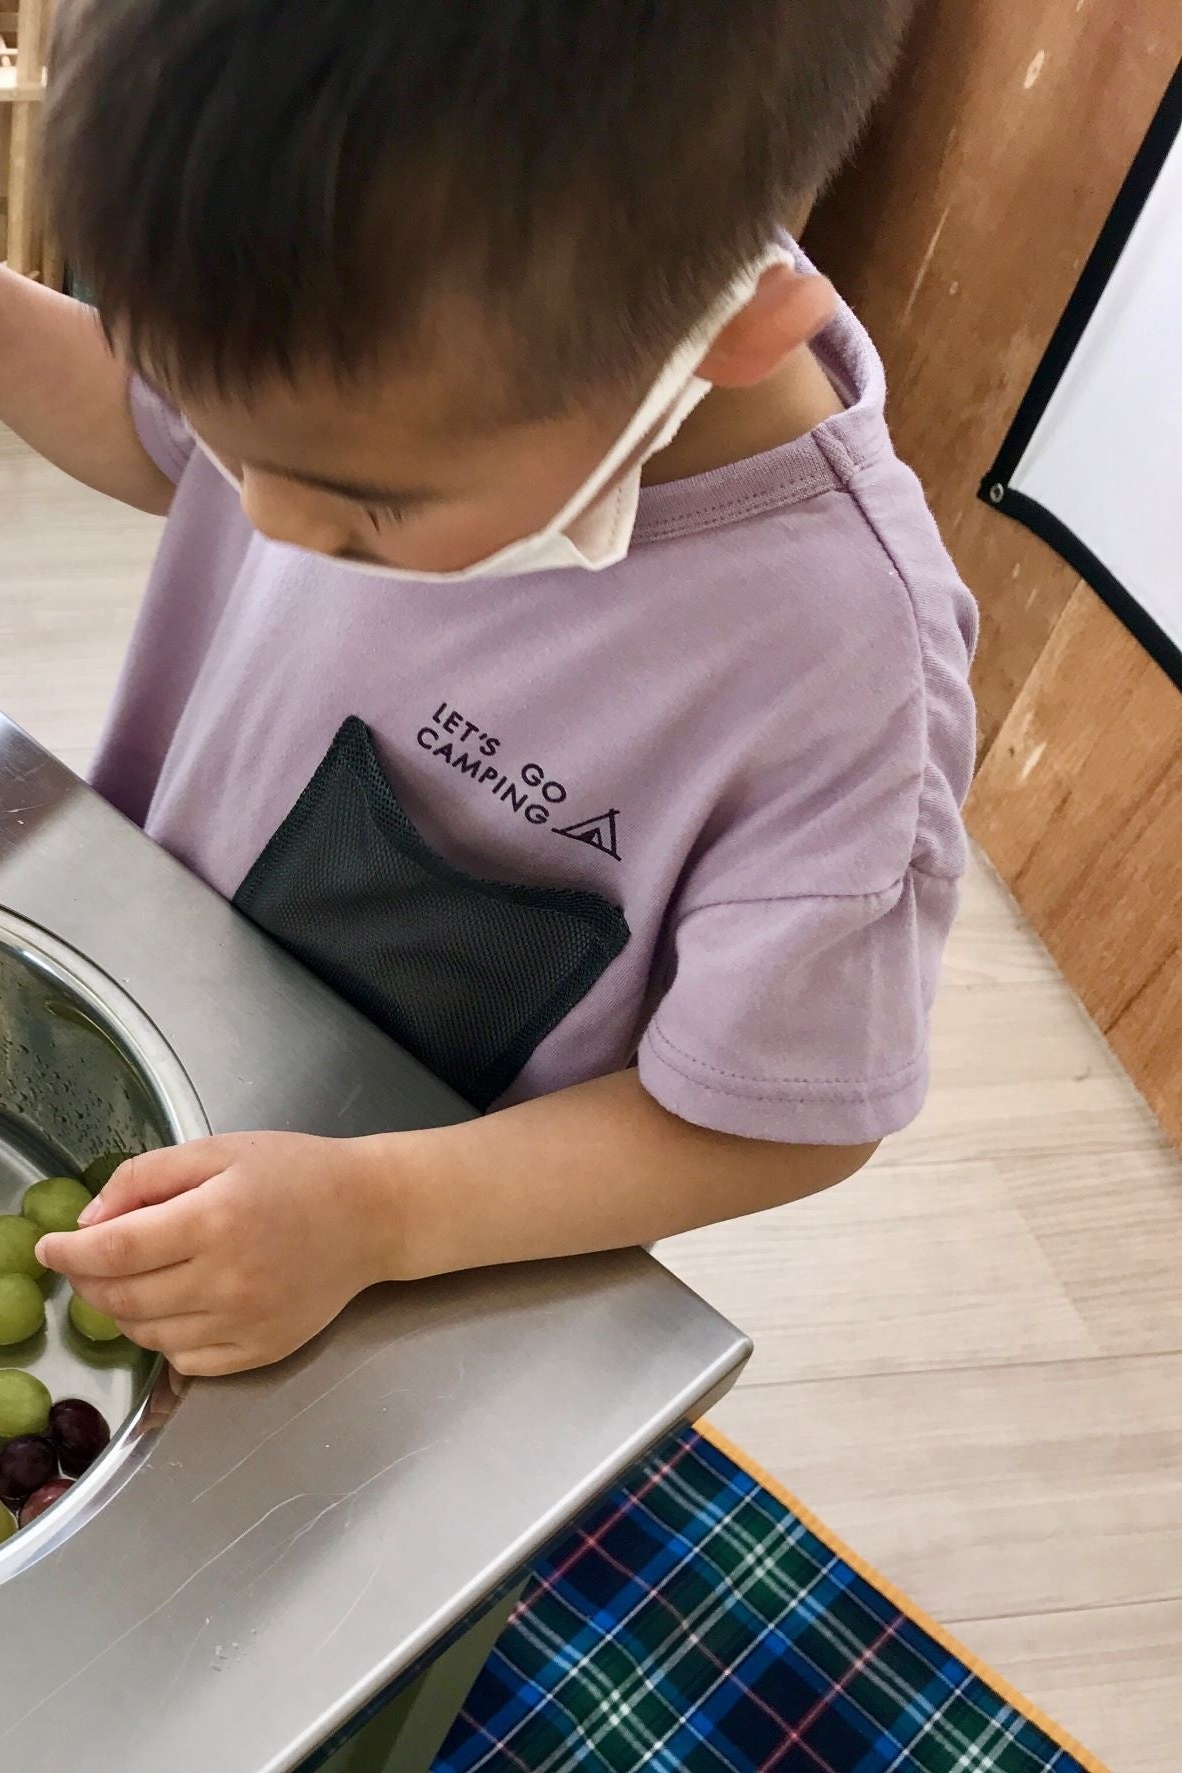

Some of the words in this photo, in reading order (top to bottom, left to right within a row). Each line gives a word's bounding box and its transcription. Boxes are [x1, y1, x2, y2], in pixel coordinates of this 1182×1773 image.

[417, 727, 550, 825] CAMPING
[432, 702, 500, 756] LET'S
[521, 763, 567, 803] GO
